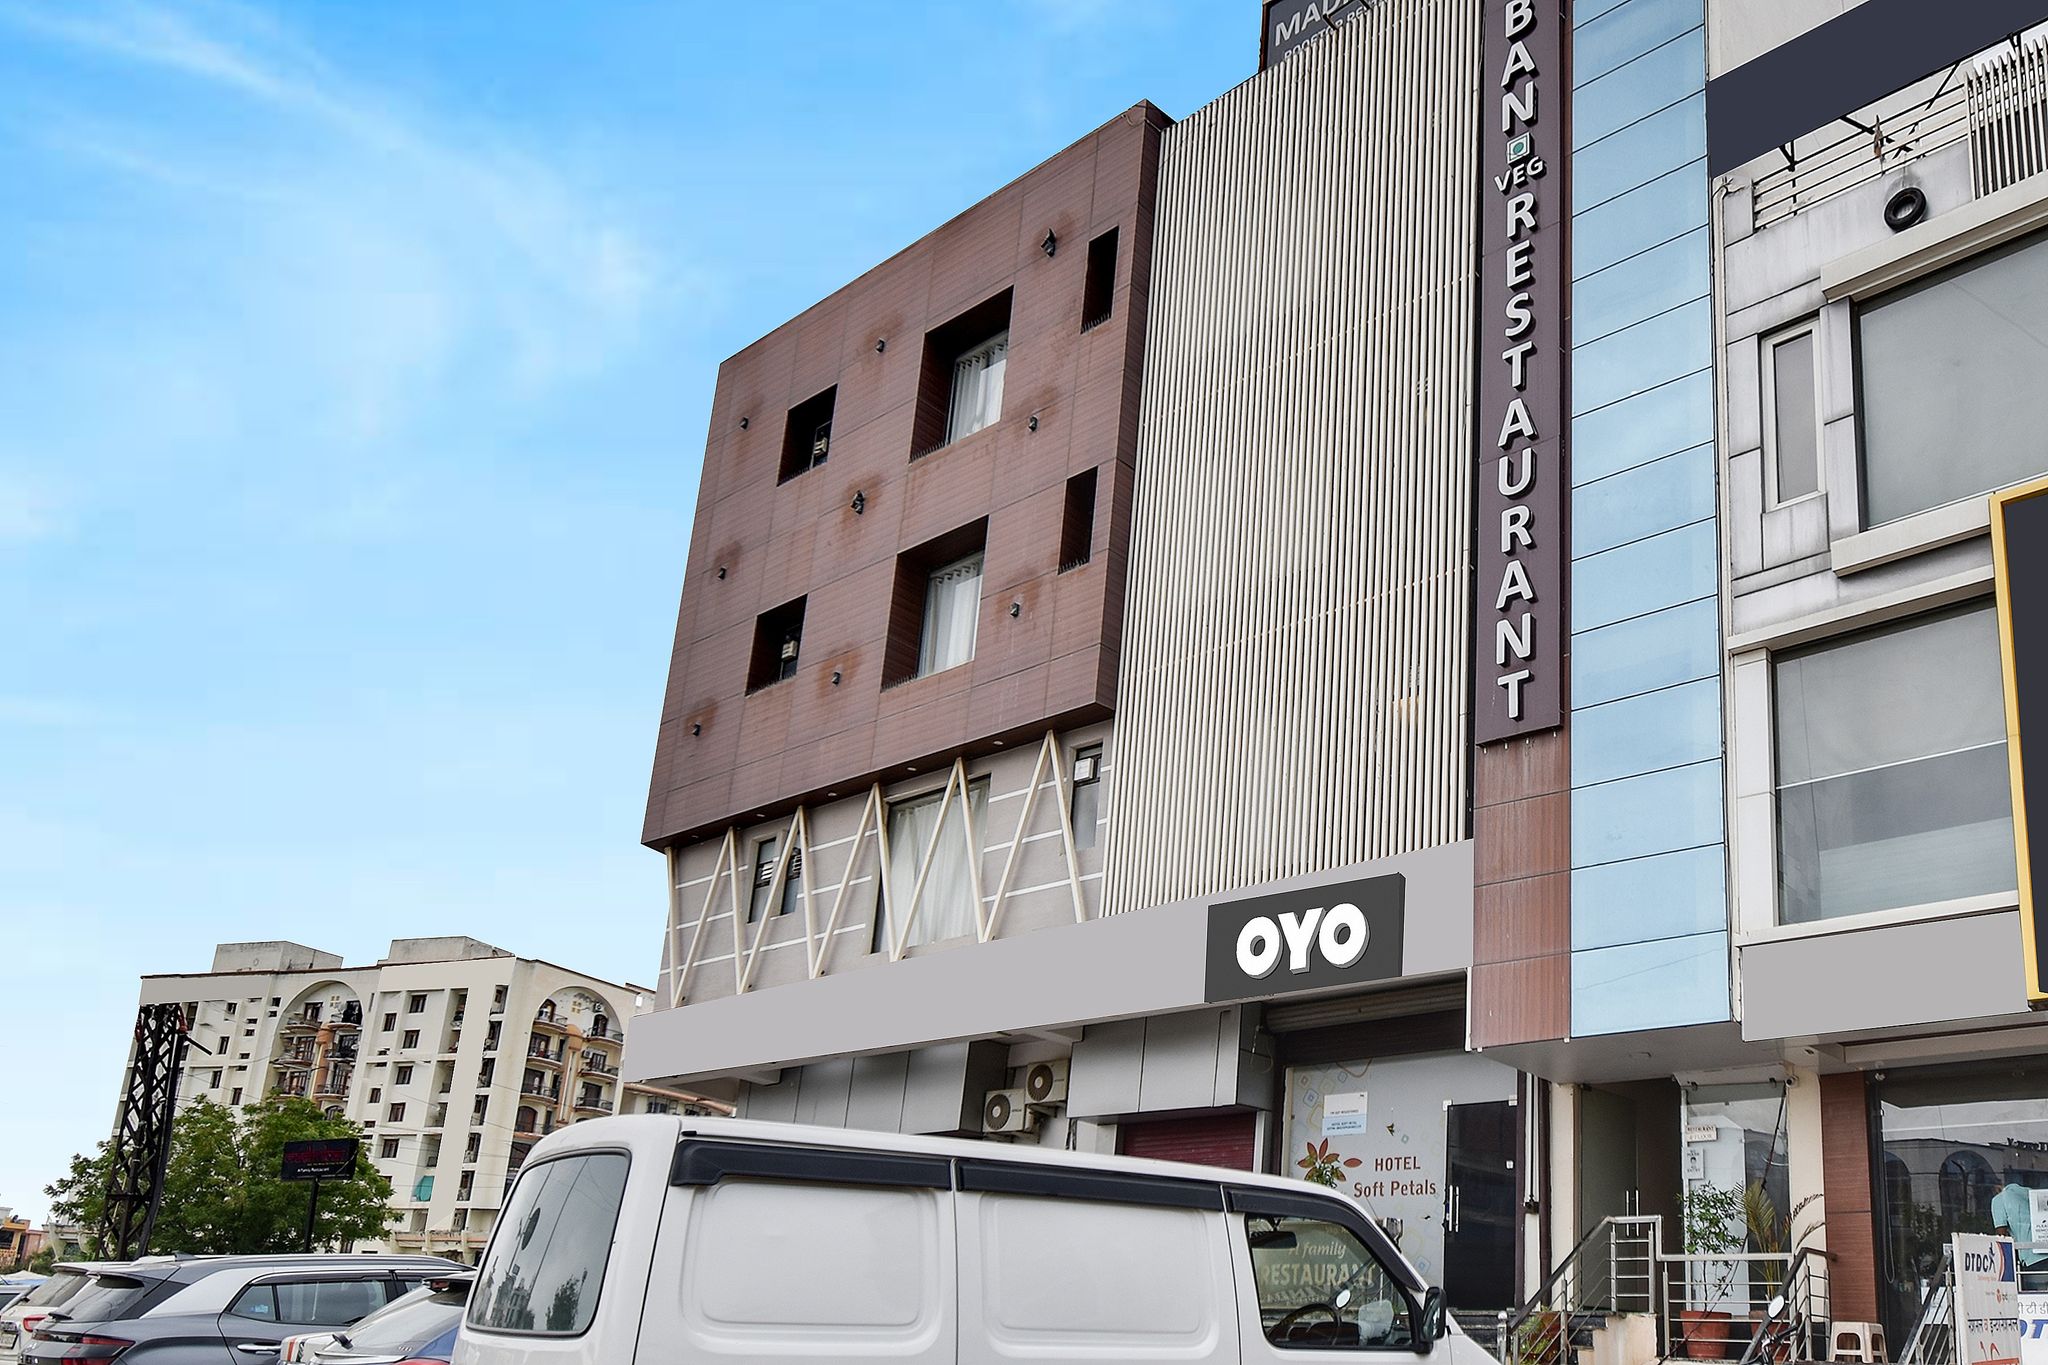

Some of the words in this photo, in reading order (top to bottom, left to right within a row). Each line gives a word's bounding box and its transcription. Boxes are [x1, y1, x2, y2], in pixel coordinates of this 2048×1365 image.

[1275, 0, 1350, 47] MAD
[1501, 0, 1537, 132] BAN
[1494, 156, 1546, 193] VEG
[1496, 192, 1537, 720] RESTAURANT
[1236, 903, 1370, 980] OYO
[1375, 1156, 1421, 1172] HOTEL
[1354, 1181, 1384, 1198] Soft
[1391, 1179, 1436, 1196] Petals
[1302, 1241, 1347, 1259] family
[1964, 1252, 1990, 1273] DTDC
[1262, 1263, 1376, 1288] RESTAURANT
